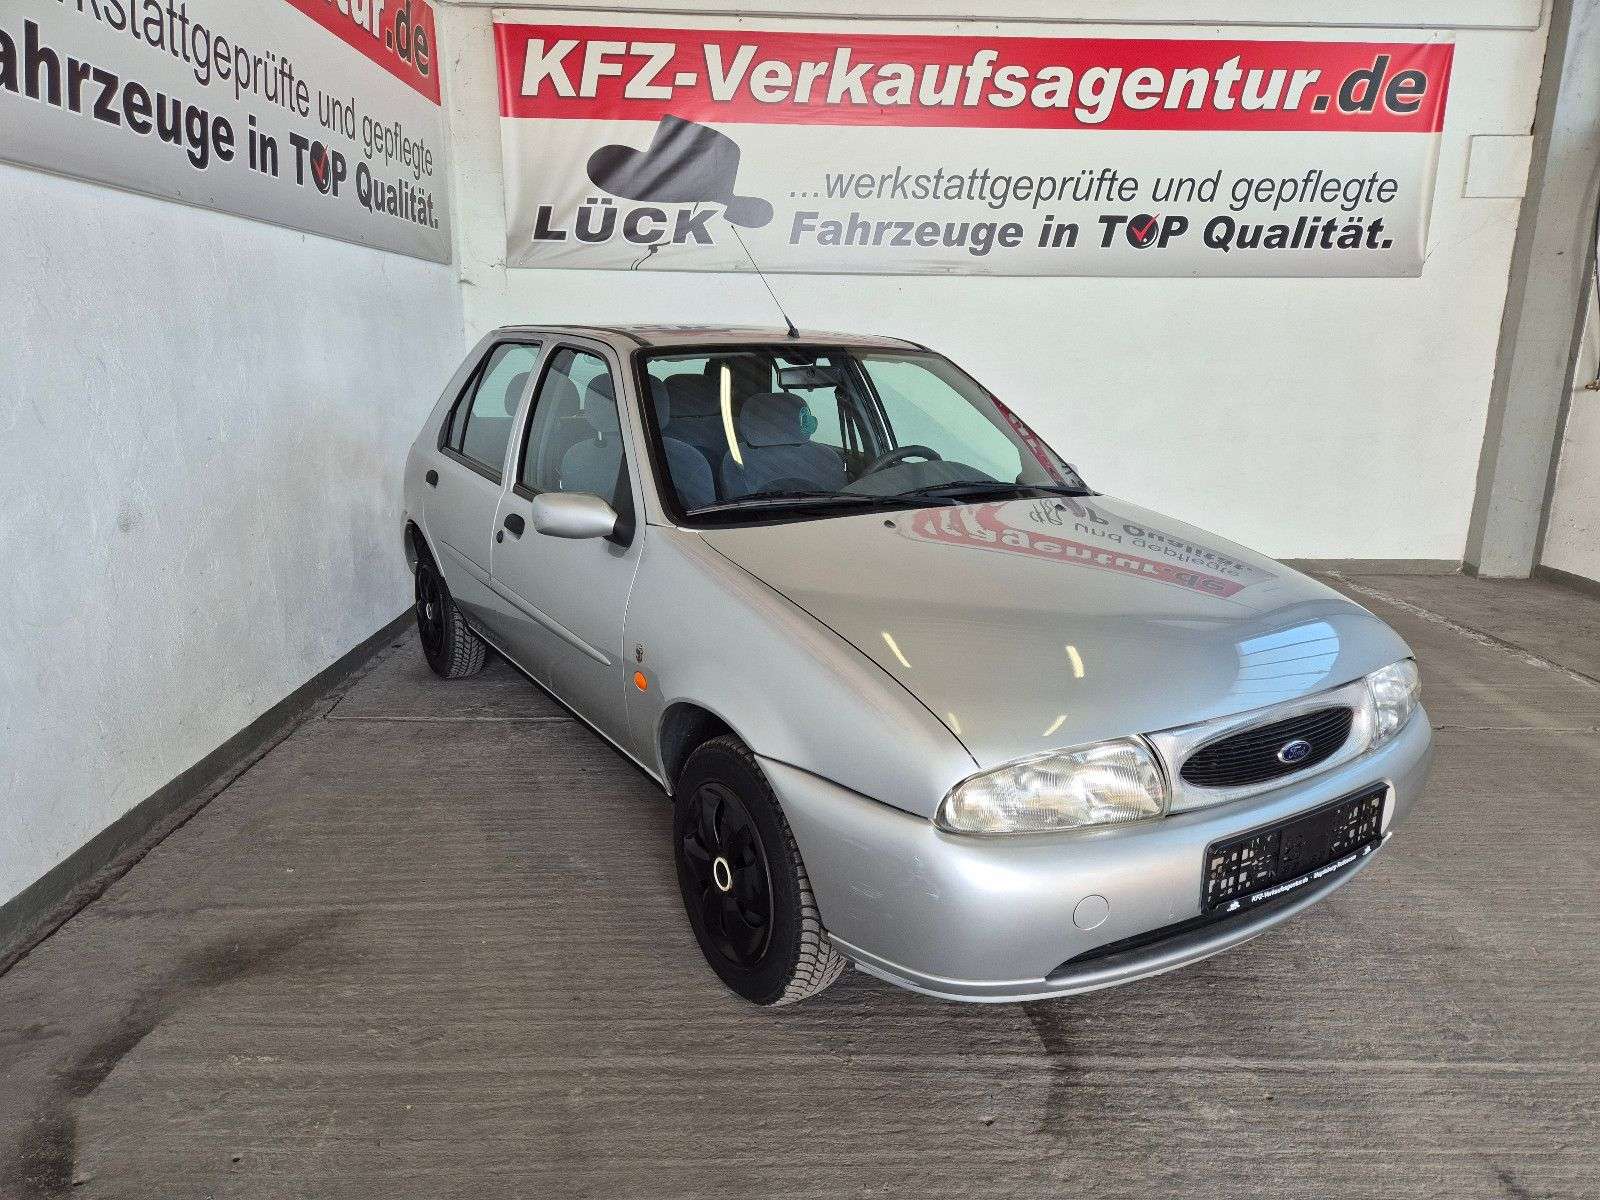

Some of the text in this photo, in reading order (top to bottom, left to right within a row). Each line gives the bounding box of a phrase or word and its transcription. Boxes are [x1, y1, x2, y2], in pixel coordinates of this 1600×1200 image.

[335, 0, 429, 77] ur.de
[57, 0, 433, 181] stattgeprüfte und gepflegte
[520, 38, 1428, 125] KFZ-Verkaufsagentur.de
[248, 114, 279, 178] in
[289, 131, 347, 196] TOP
[355, 161, 439, 230] Qualität.
[1152, 169, 1222, 204] und
[1229, 169, 1400, 212] gepflegte
[533, 197, 719, 245] LÜCK
[789, 210, 1394, 256] Fahrzeuge in TOP Qualität.
